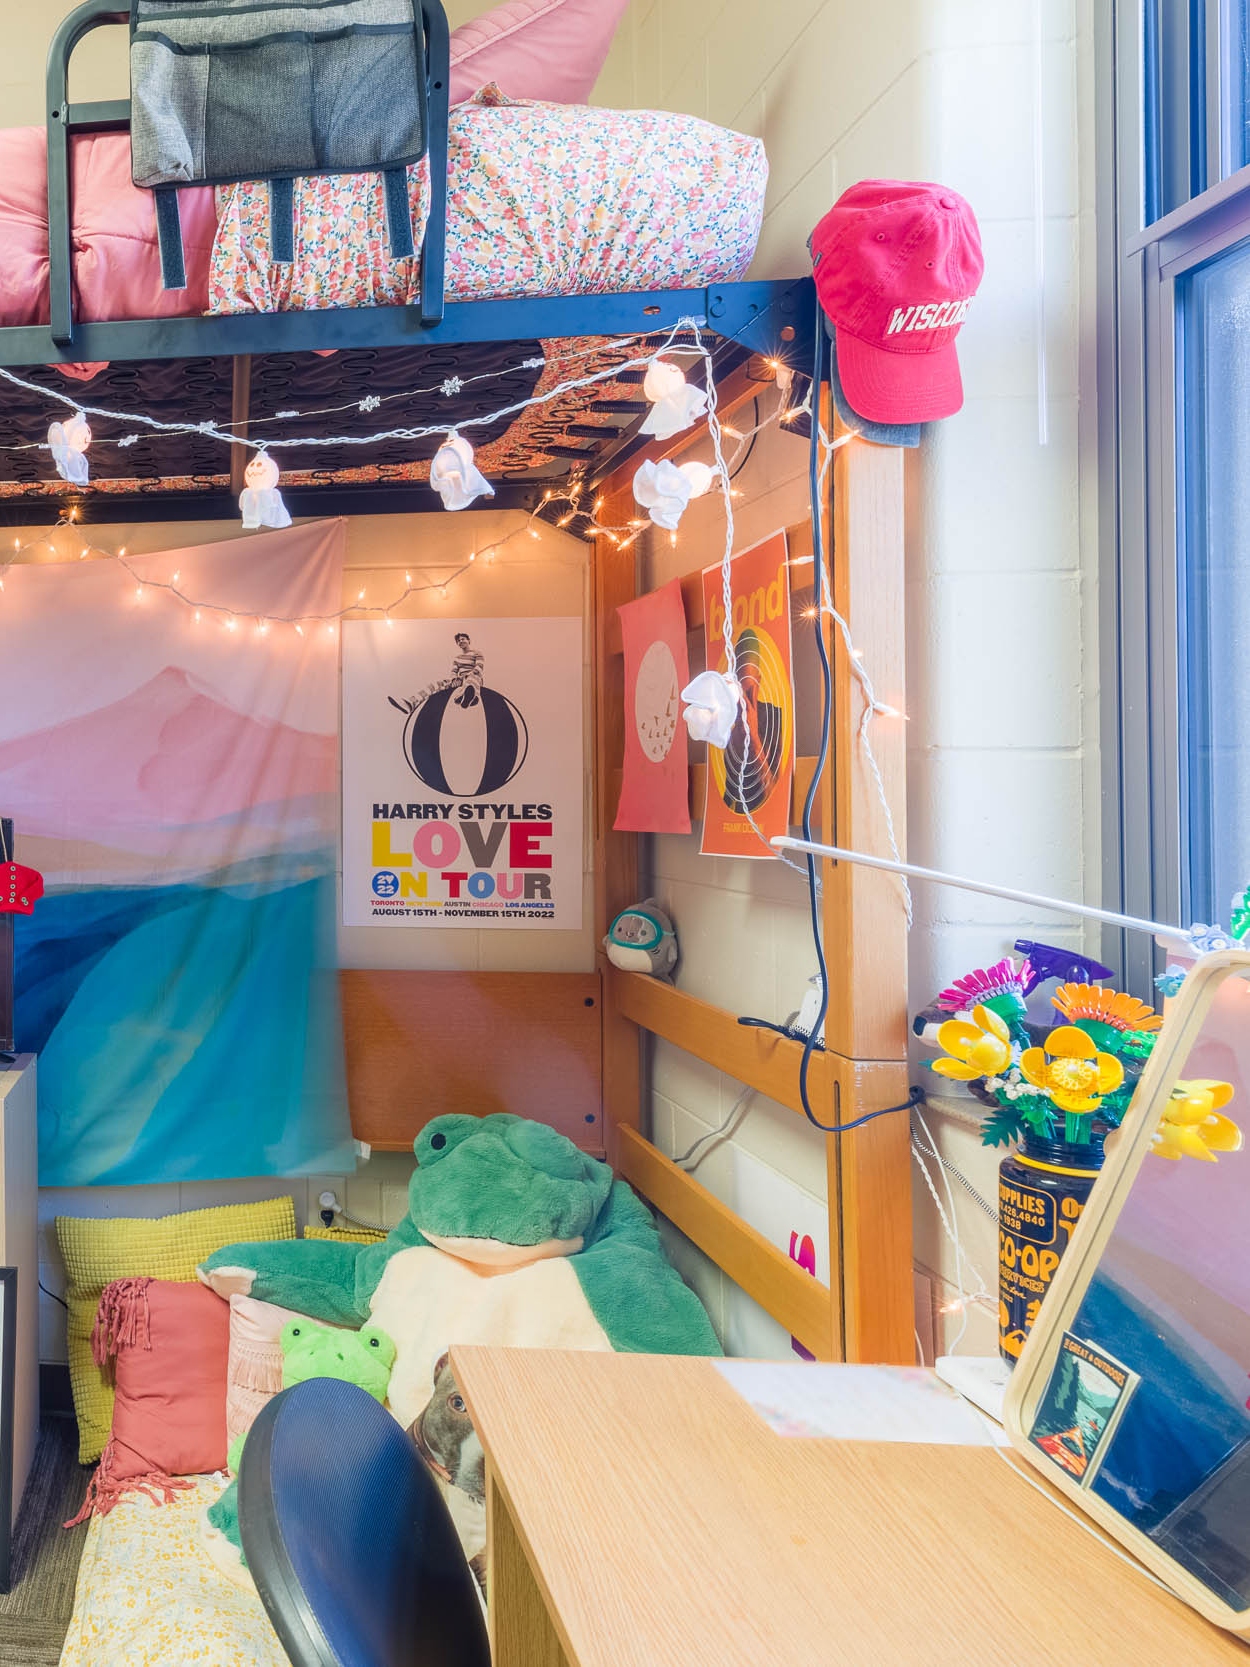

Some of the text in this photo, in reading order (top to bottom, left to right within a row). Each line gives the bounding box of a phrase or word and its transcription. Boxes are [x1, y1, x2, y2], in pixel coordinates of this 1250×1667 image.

[710, 563, 784, 643] bond
[372, 803, 553, 820] HARRY STYLES
[372, 820, 553, 869] LOVE
[441, 871, 552, 899] TOUR
[372, 908, 411, 916] AUGUST
[444, 909, 499, 917] NOVEMBER
[501, 910, 526, 918] 15TH
[527, 910, 555, 918] 2022
[1093, 1356, 1126, 1387] OUTDOORS
